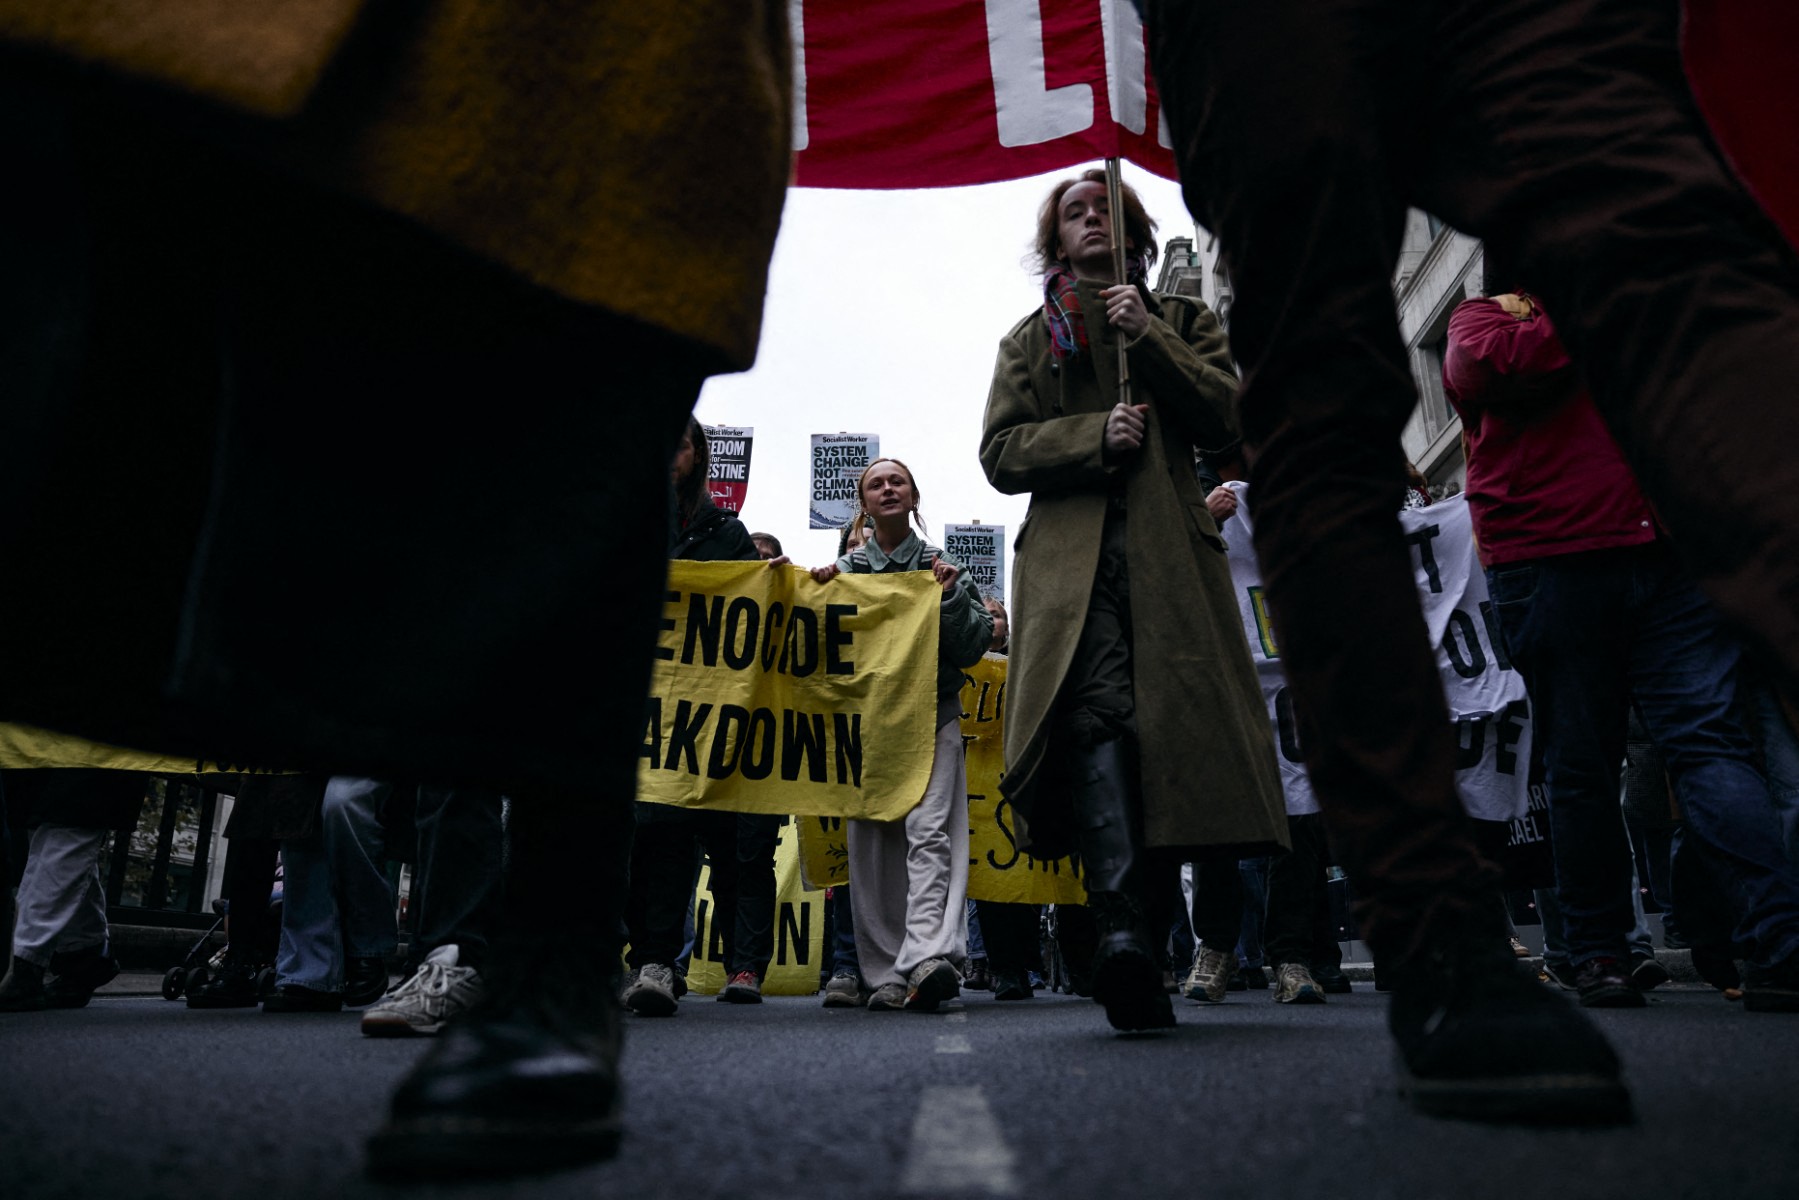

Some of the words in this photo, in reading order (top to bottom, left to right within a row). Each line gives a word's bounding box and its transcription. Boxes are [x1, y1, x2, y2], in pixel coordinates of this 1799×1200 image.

[814, 446, 866, 457] SYSTEM
[711, 455, 720, 463] for
[813, 457, 869, 468] CHANGE
[814, 468, 840, 478] NOT
[947, 535, 993, 546] SYSTEM
[947, 546, 995, 556] CHANGE
[957, 556, 971, 565] OT
[966, 566, 997, 575] MATE
[972, 576, 995, 585] NGE
[655, 591, 858, 677] ENOCIDE
[641, 697, 863, 787] AKDOWN
